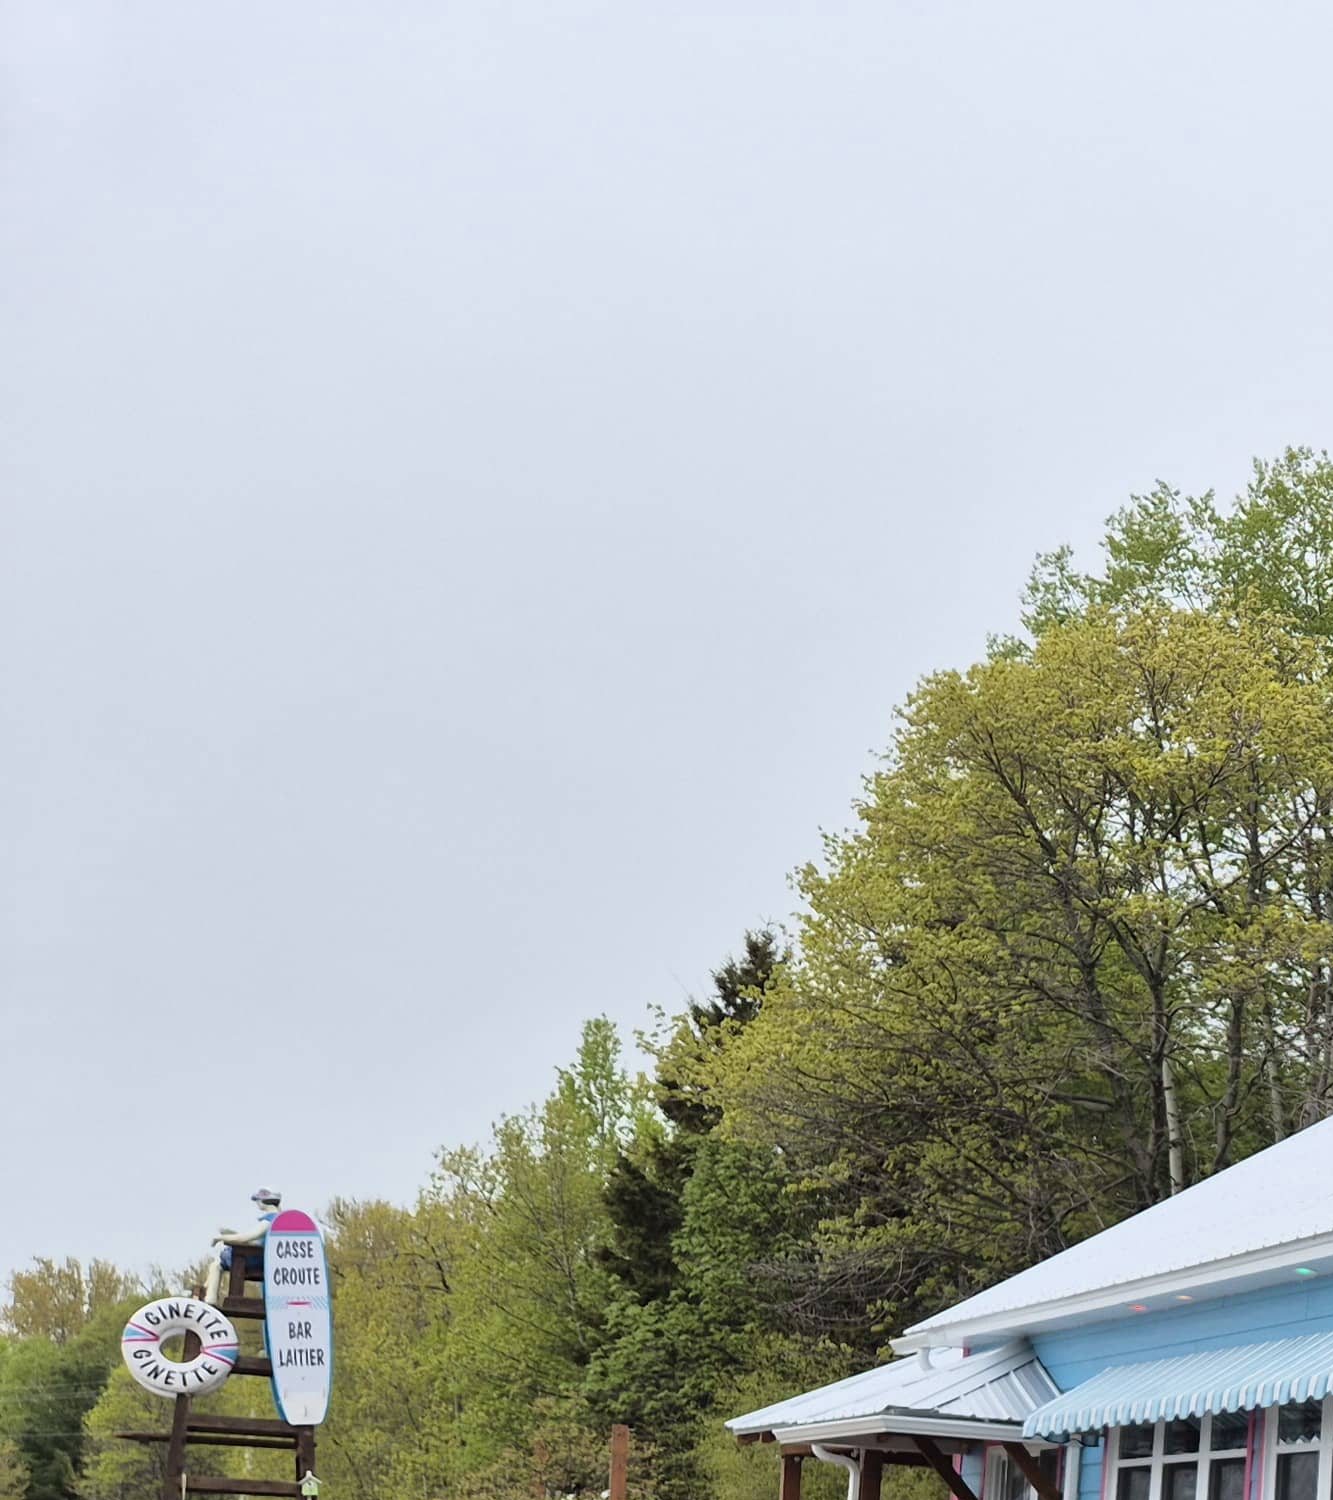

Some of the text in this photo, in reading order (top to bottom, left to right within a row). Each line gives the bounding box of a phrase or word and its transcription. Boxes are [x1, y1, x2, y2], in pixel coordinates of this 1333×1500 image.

[276, 1240, 314, 1259] CASSE
[273, 1267, 320, 1286] CROUTE
[144, 1302, 229, 1341] GINETTE
[288, 1321, 313, 1340] BAR
[279, 1348, 325, 1368] LAITIER
[132, 1349, 219, 1388] GINETTE
